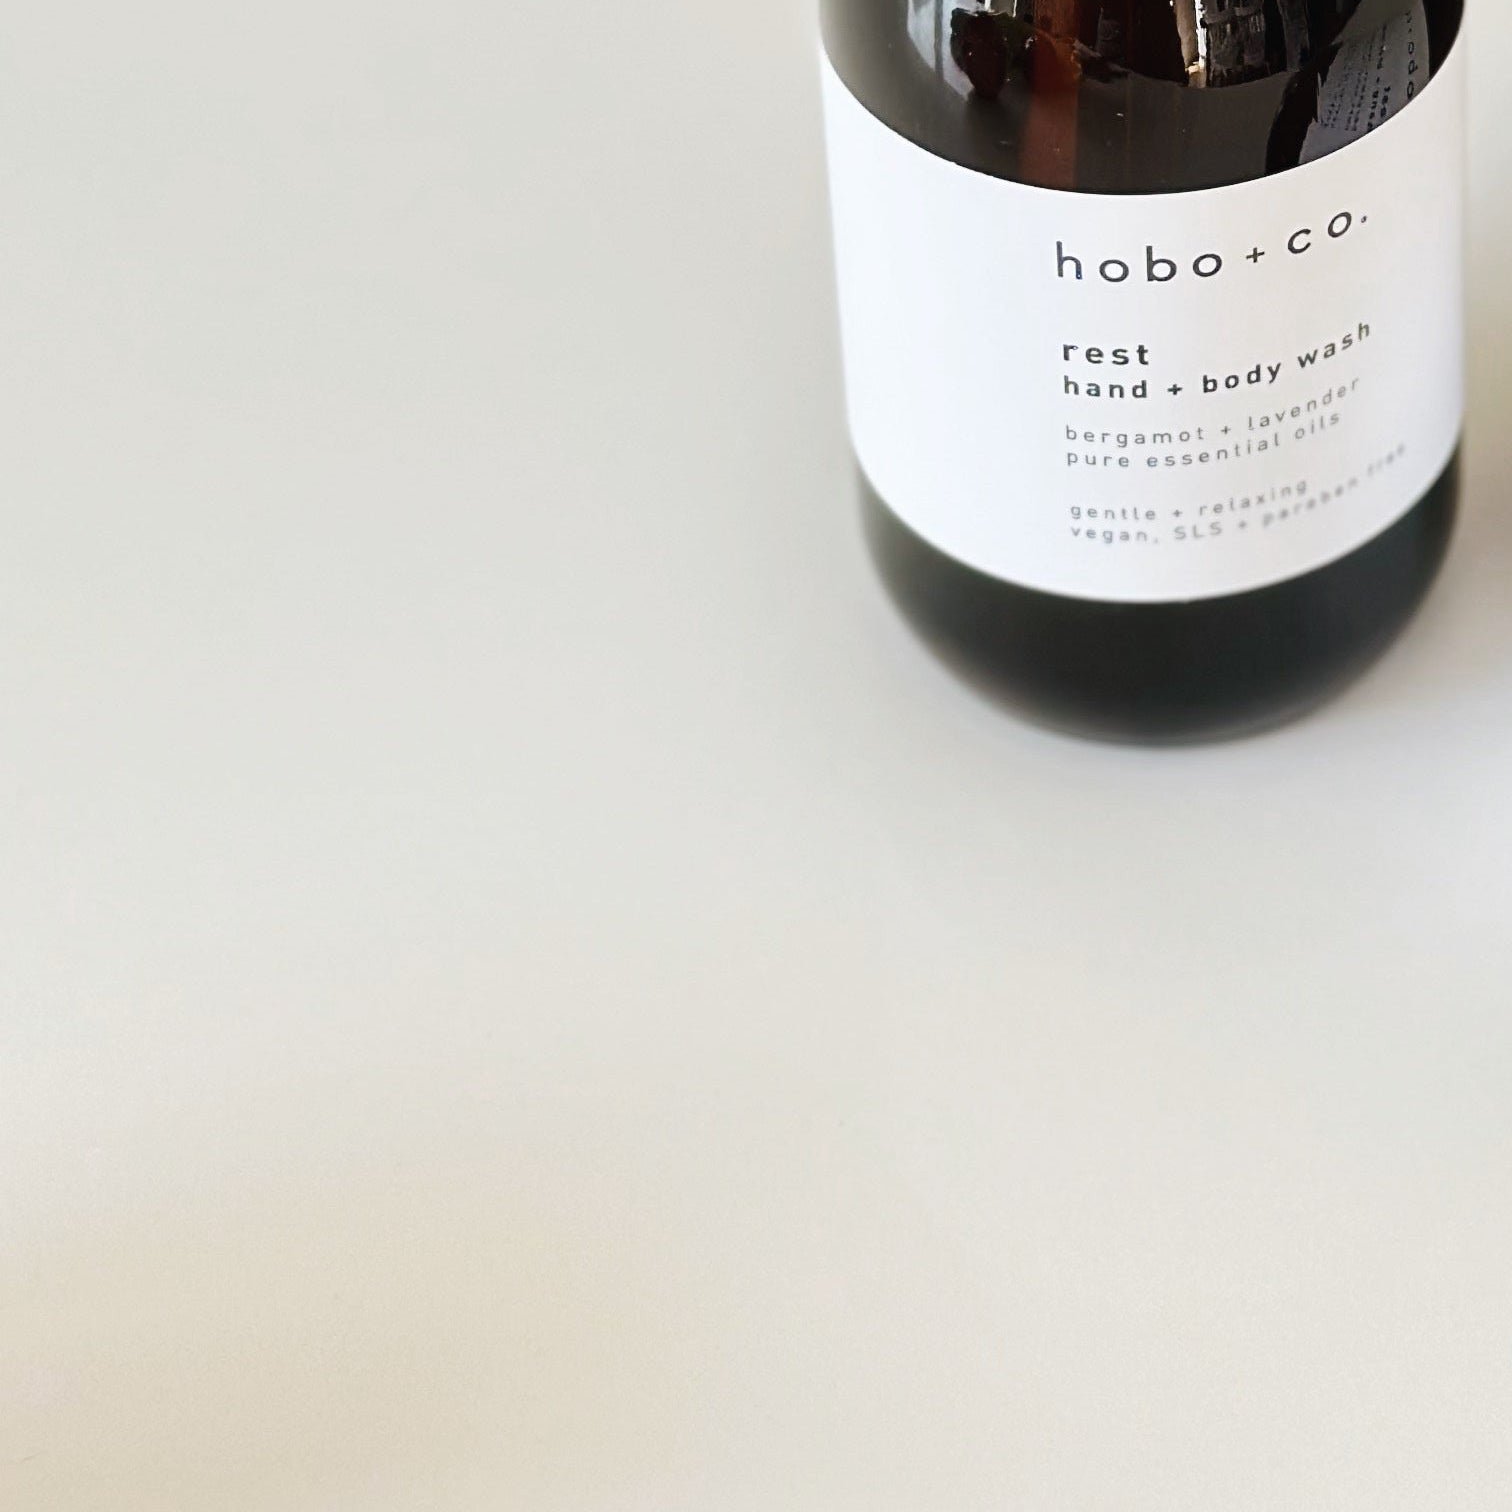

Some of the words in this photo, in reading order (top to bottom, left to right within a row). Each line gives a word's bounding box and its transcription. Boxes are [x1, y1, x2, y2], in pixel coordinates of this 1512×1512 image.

[1056, 241, 1224, 282] hobo
[1245, 246, 1266, 263] +
[1286, 211, 1368, 255] co.
[1062, 343, 1150, 366] rest
[1063, 375, 1148, 399] hand
[1167, 383, 1183, 396] +
[1202, 362, 1282, 394] body
[1296, 322, 1371, 369] wash
[1065, 424, 1205, 449] bergamot
[1220, 425, 1232, 435] +
[1248, 377, 1360, 431] lavender
[1066, 452, 1130, 468] pure
[1146, 432, 1281, 468] essential
[1294, 411, 1341, 440] oils
[1070, 505, 1156, 520] gentle
[1172, 509, 1183, 518] +
[1199, 479, 1308, 517] relaxing
[1070, 527, 1160, 545] vegan,
[1173, 520, 1223, 541] SLS
